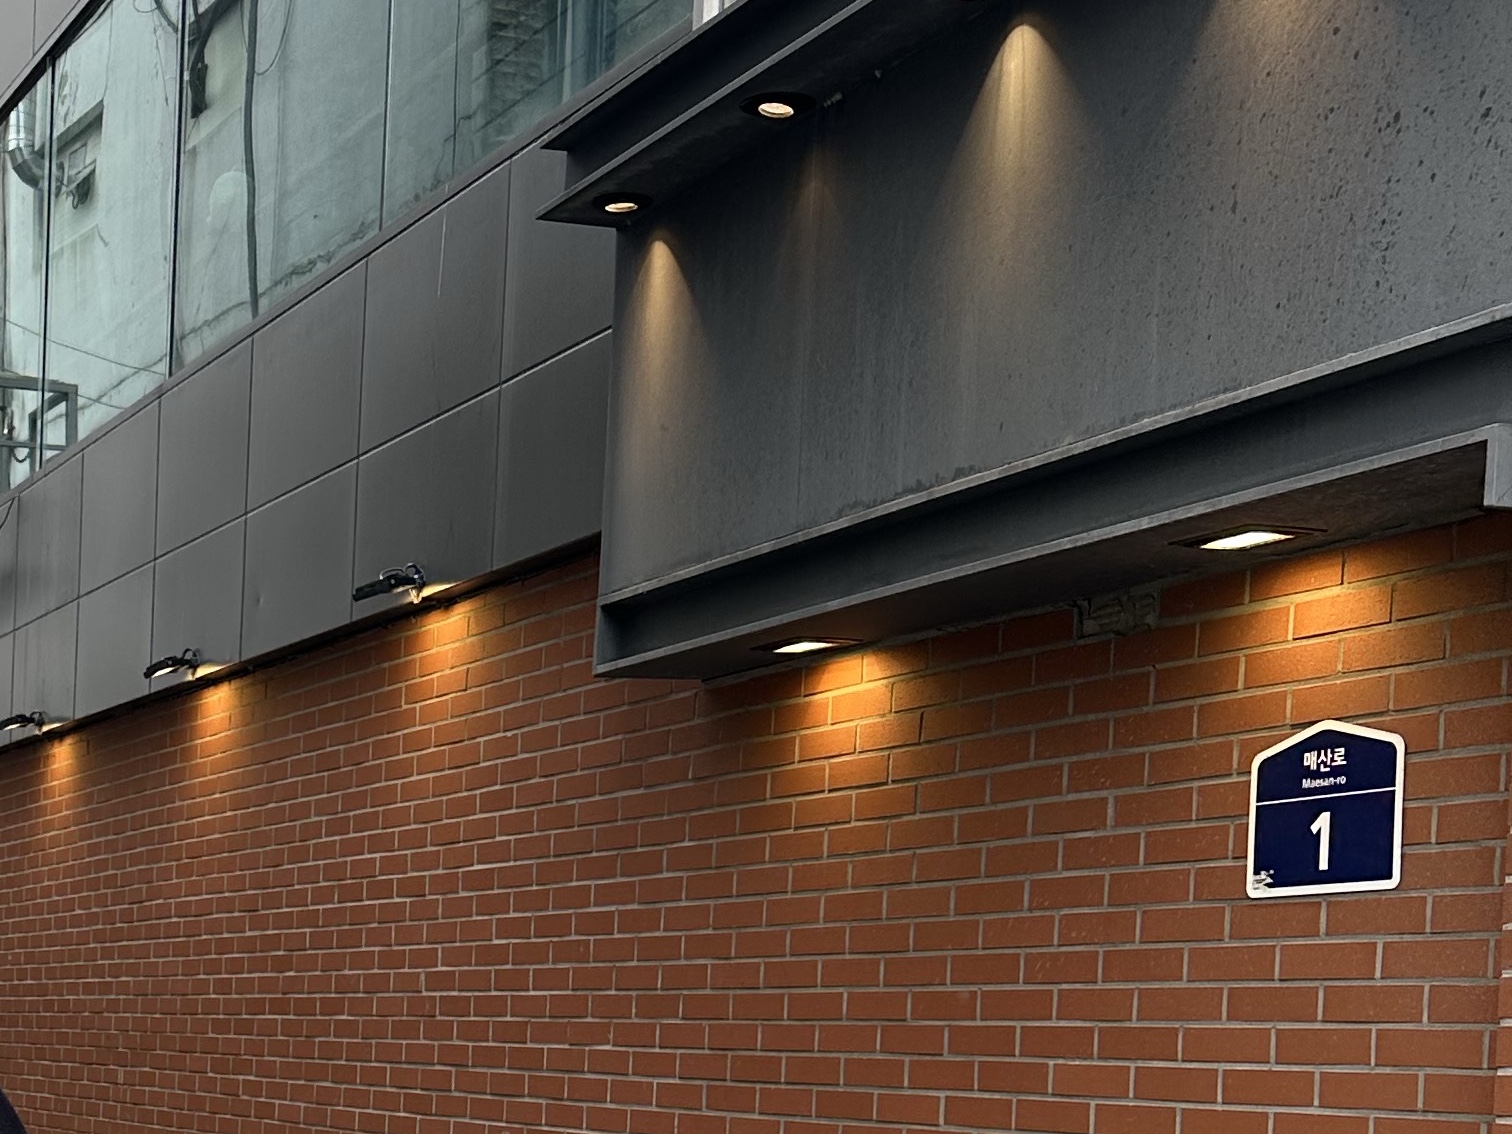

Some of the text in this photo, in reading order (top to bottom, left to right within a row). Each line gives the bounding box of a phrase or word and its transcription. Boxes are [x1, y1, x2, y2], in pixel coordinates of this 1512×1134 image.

[1303, 747, 1348, 772] 매산로
[1301, 775, 1347, 789] Maesan-ro
[1309, 811, 1331, 871] 1
